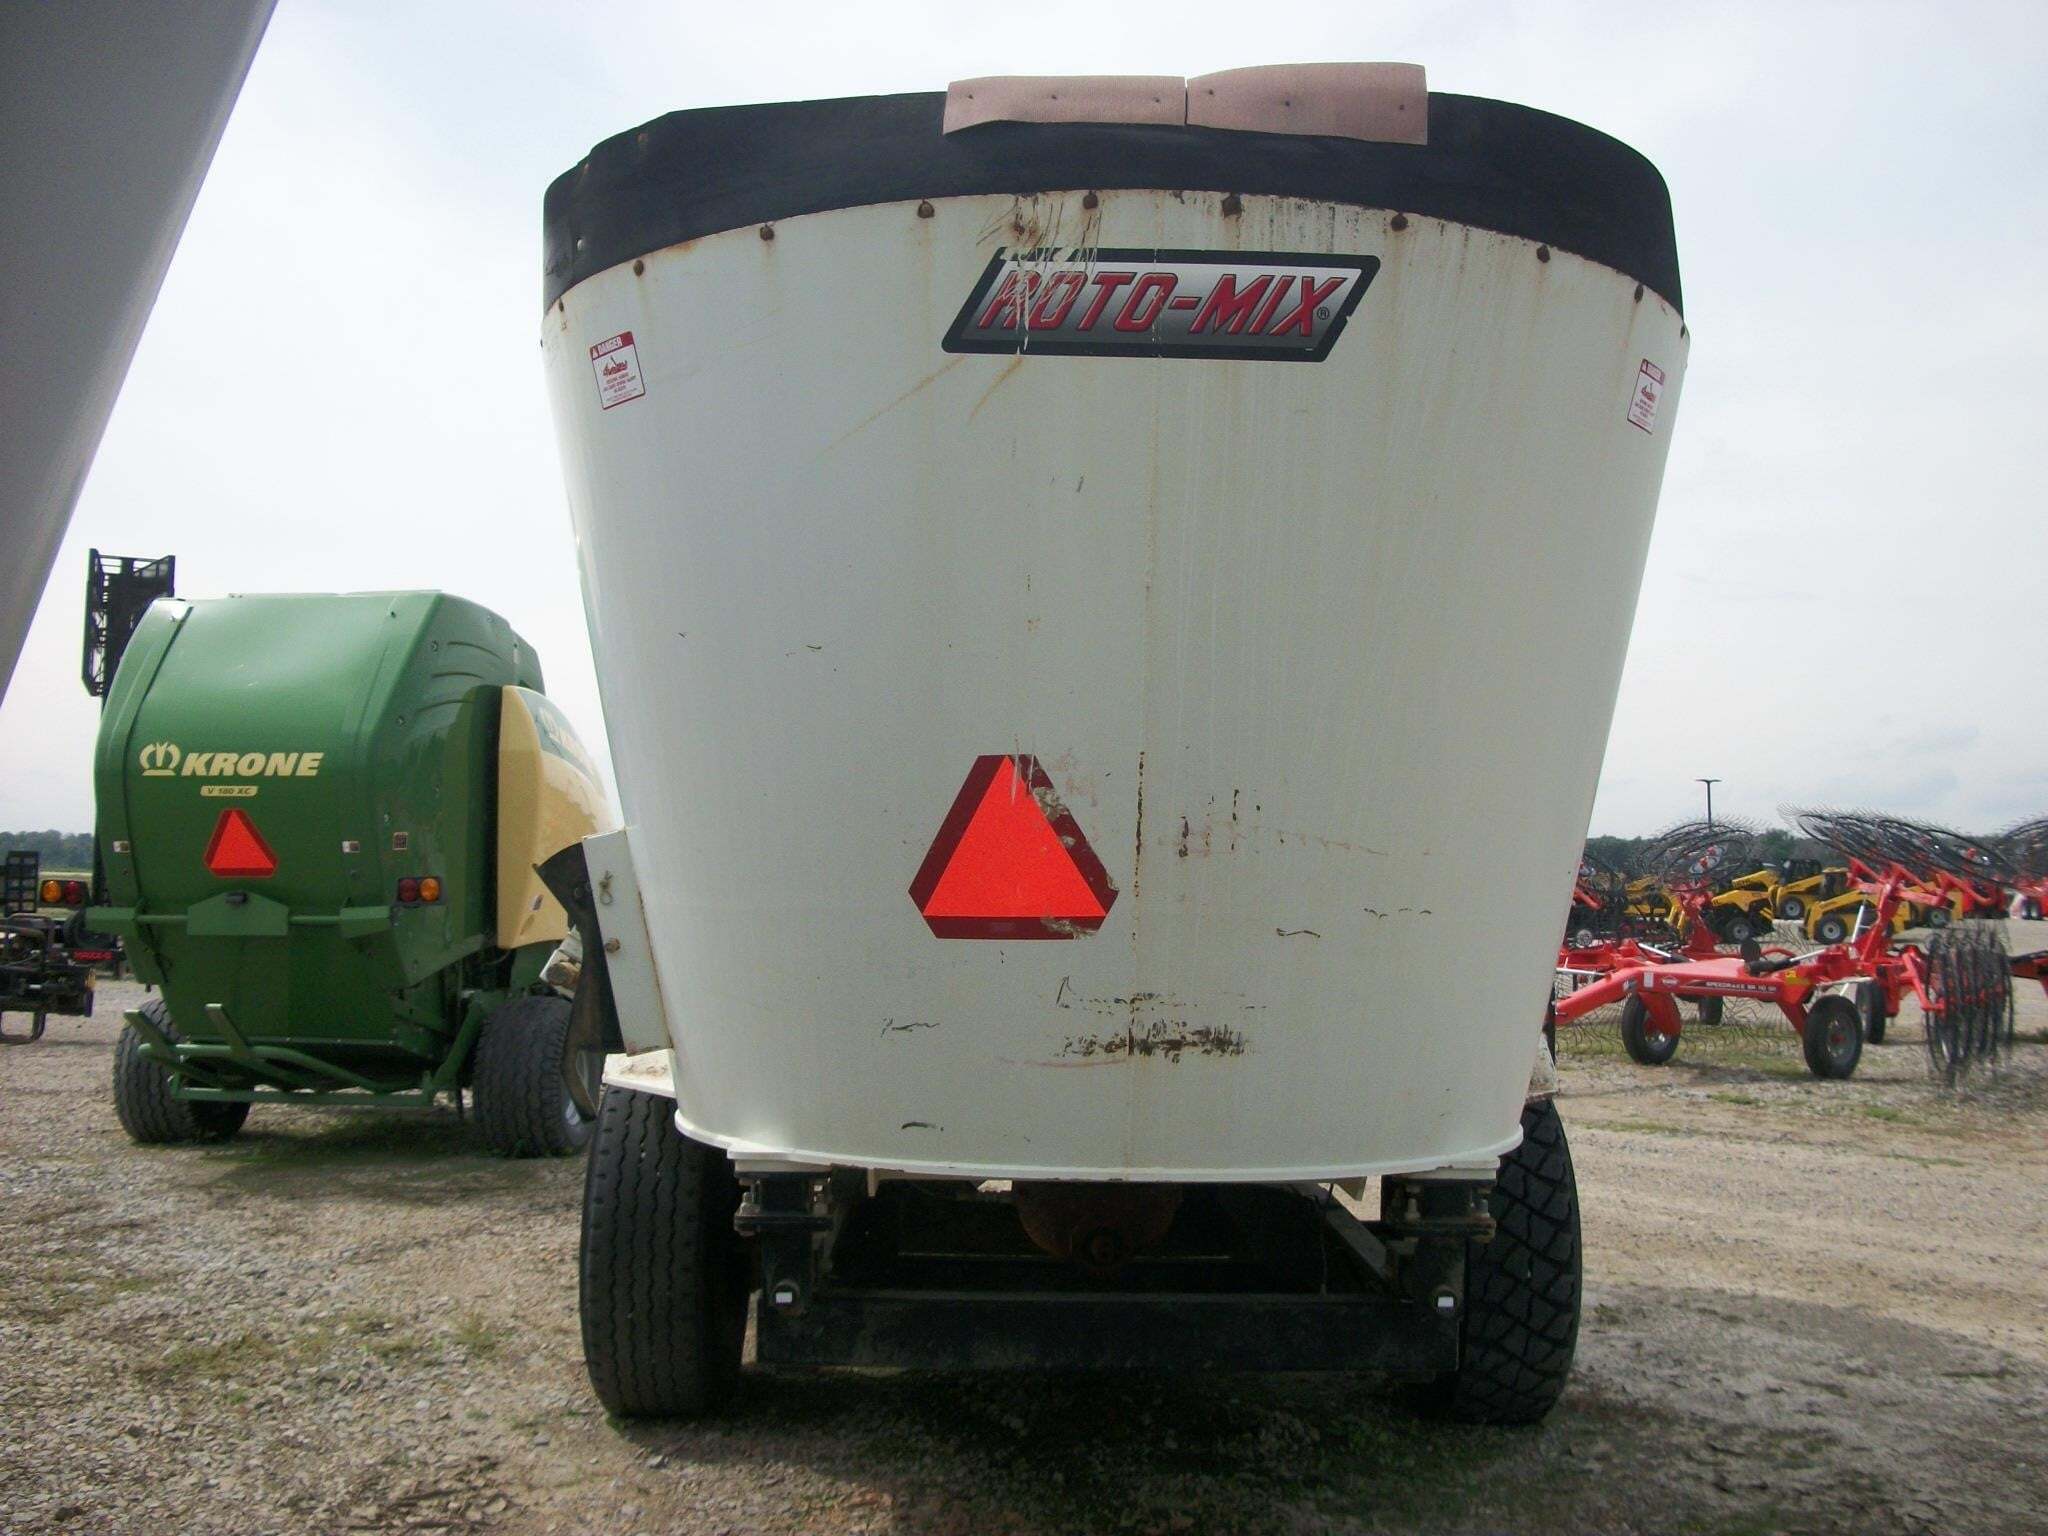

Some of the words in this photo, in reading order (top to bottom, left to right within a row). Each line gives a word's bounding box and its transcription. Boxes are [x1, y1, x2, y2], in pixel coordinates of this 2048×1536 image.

[976, 271, 1348, 337] ROTO-MIX
[181, 752, 324, 777] KRONE
[207, 787, 214, 795] V
